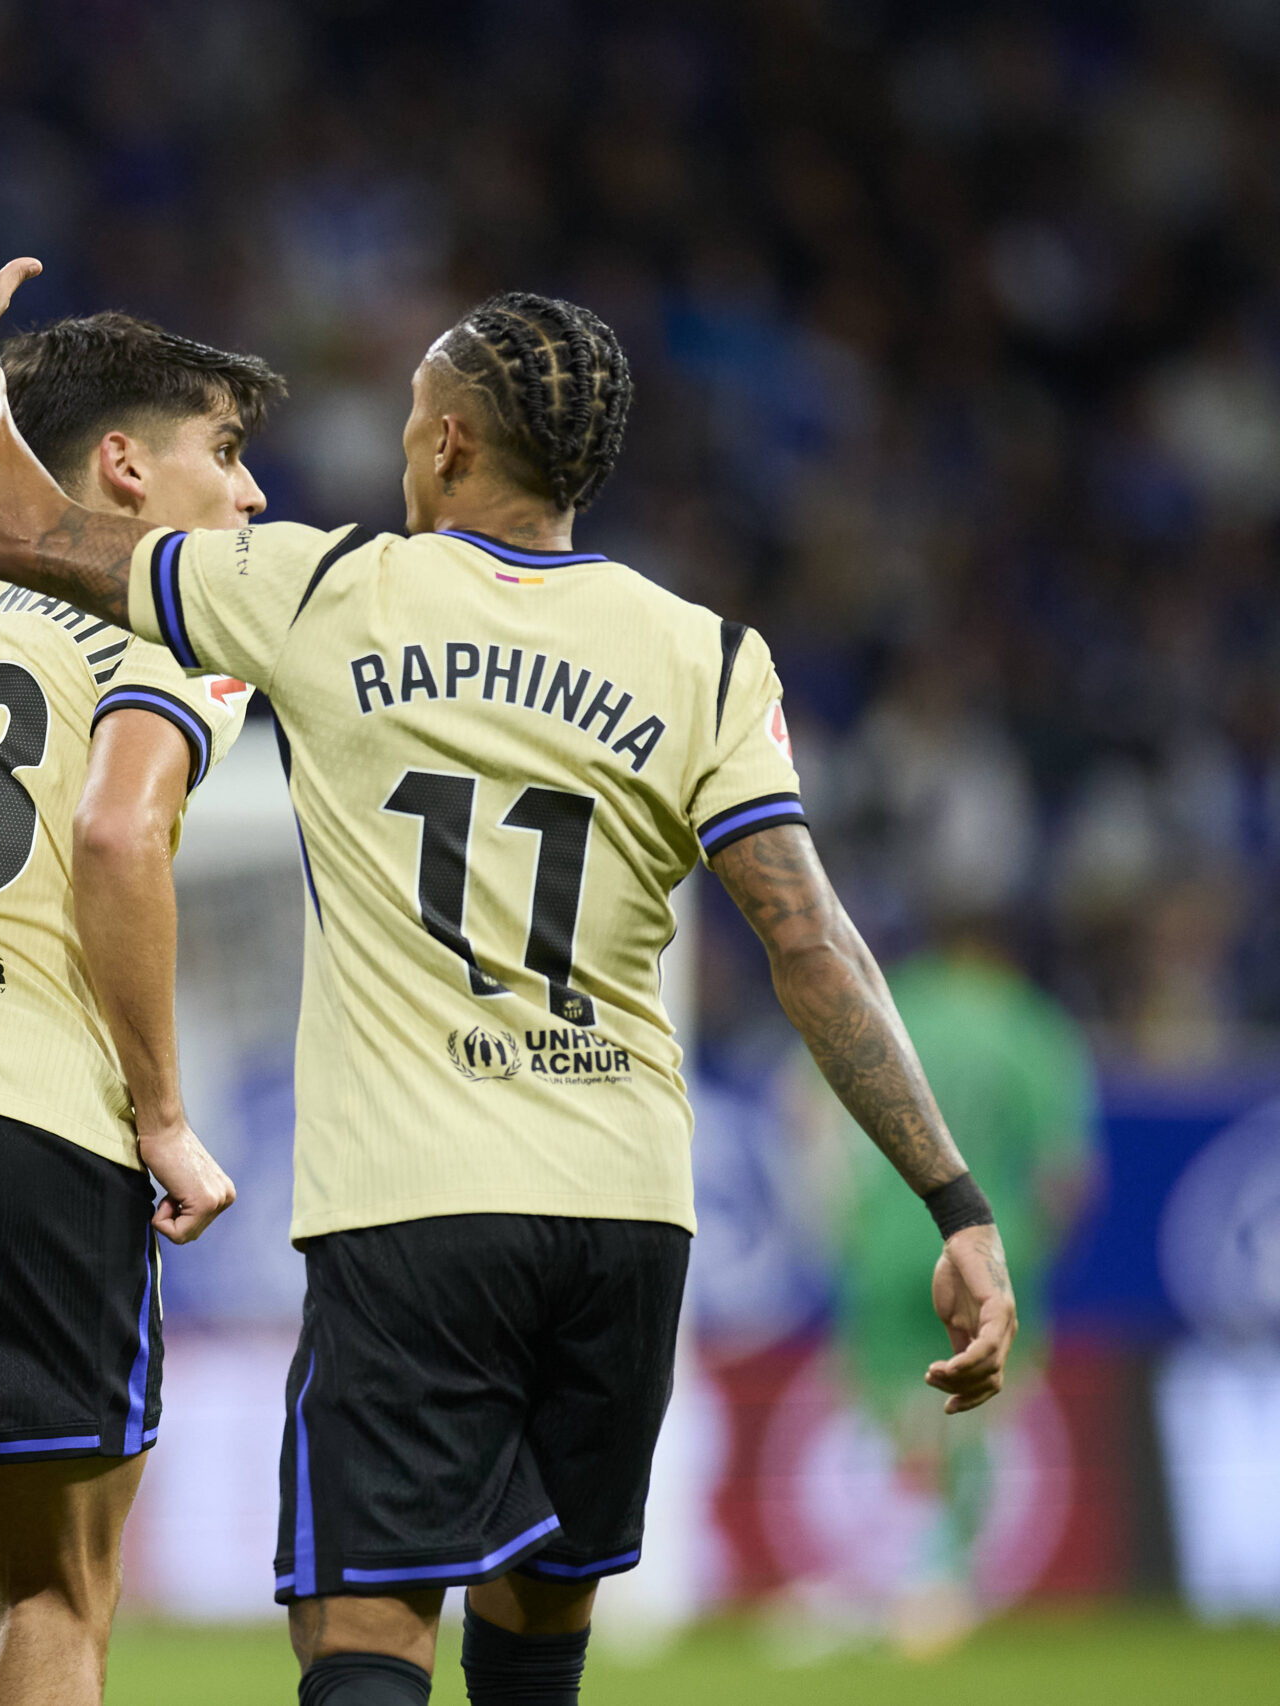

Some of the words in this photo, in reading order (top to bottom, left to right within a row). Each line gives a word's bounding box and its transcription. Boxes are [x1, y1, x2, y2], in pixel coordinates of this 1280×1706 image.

[350, 641, 666, 774] RAPHINHA
[379, 769, 597, 1028] 11
[525, 1028, 617, 1051] UNH
[531, 1050, 631, 1075] ACNUR
